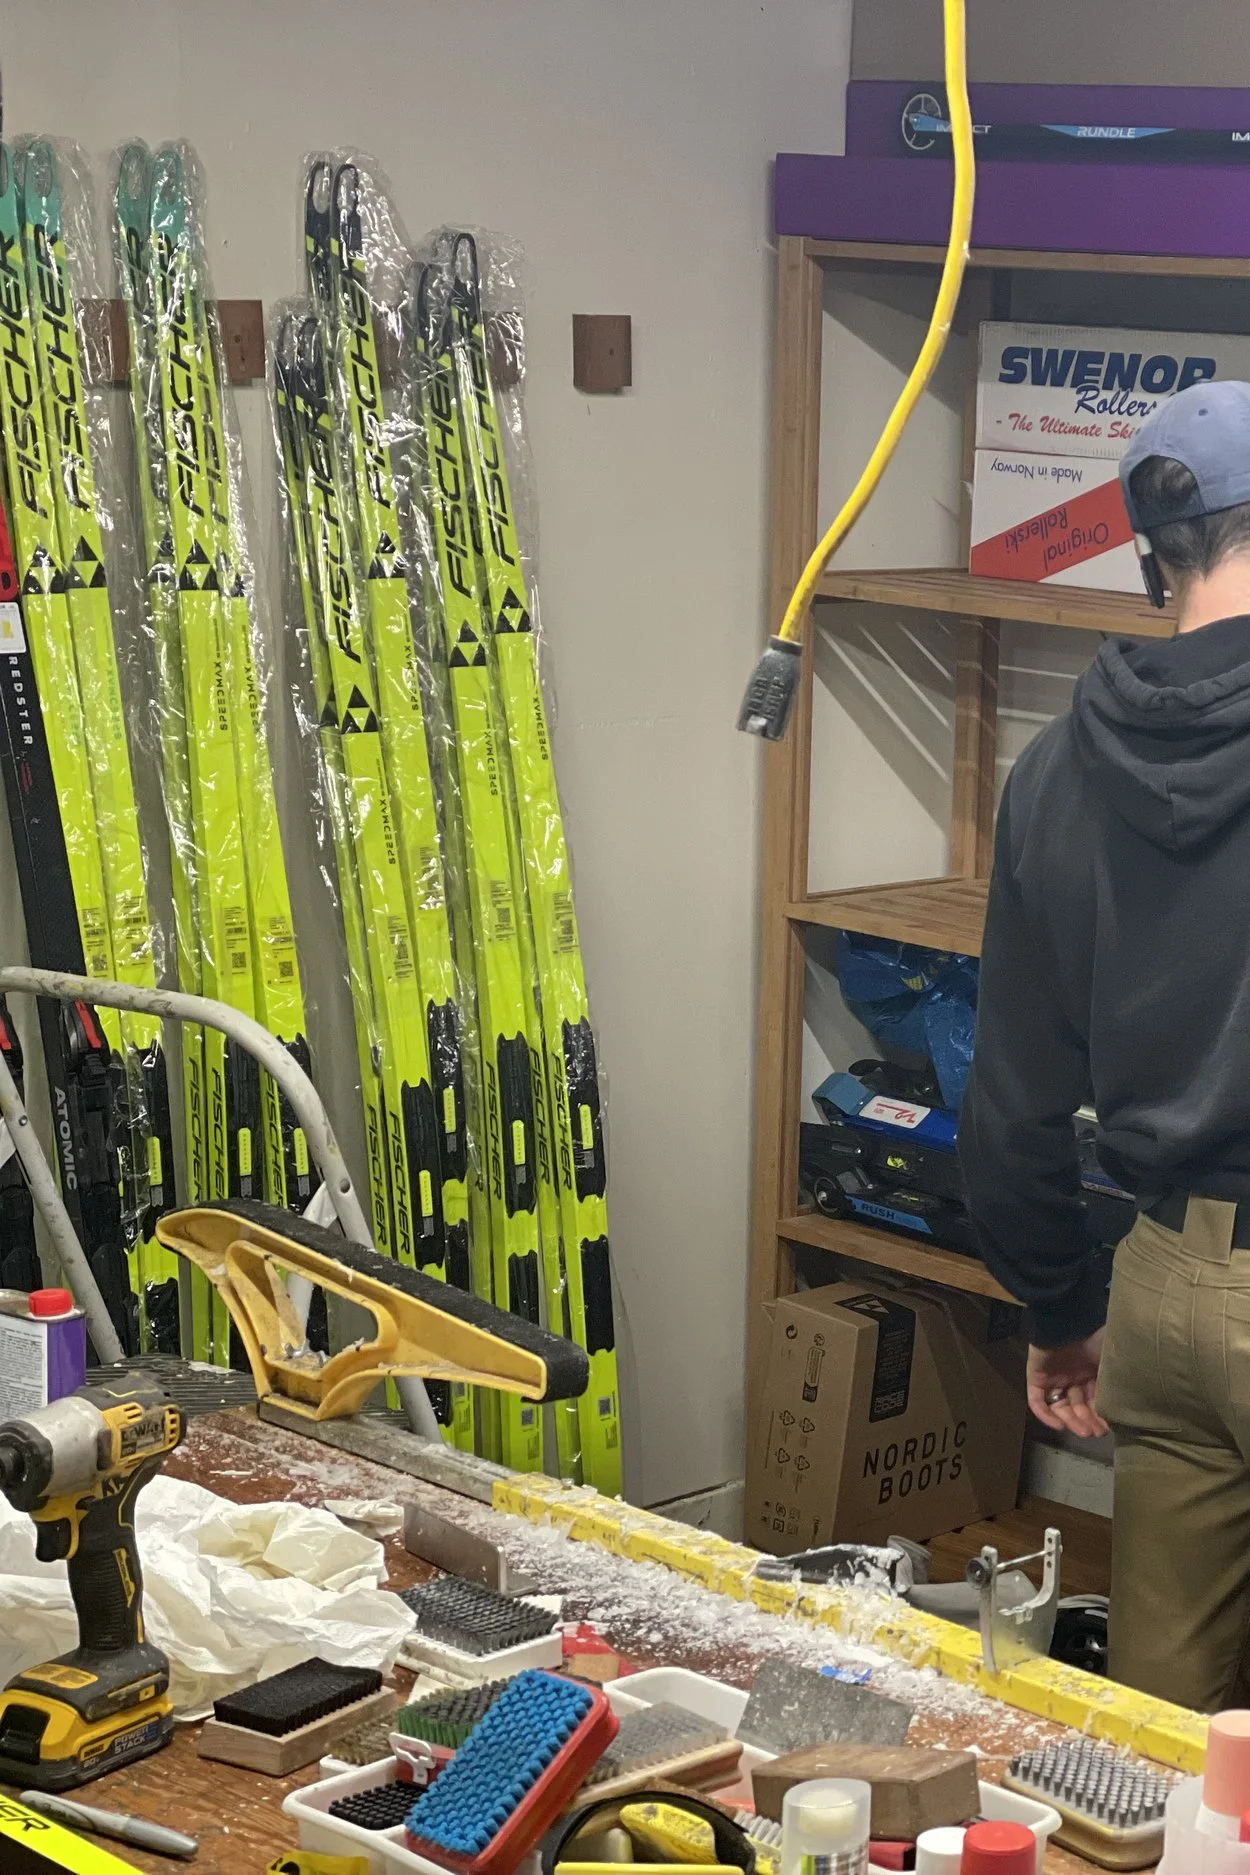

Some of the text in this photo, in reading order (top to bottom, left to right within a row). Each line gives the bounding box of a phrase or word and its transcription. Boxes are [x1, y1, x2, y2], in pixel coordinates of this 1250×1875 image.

[936, 123, 991, 134] IMCT
[1076, 126, 1136, 139] RUNDLE
[1008, 412, 1034, 433] The
[1040, 416, 1103, 438] Ultimate
[1107, 420, 1140, 440] Ski
[991, 457, 1083, 485] Made in Norway
[1004, 508, 1069, 554] Rollerski
[1043, 523, 1110, 572] Original
[9, 655, 34, 746] REDSTER
[213, 661, 228, 731] SPEEDMAX
[532, 695, 549, 761] SPEEDMAX
[484, 731, 499, 797] SPEEDMAX
[379, 798, 396, 866] SPEEDMAX
[54, 1085, 78, 1191] ATOMIC
[486, 1060, 502, 1200] FISCHER
[529, 1047, 551, 1185] FISCHER
[366, 1103, 388, 1246] FISCHER
[388, 1110, 411, 1255] FISCHER
[863, 1421, 968, 1479] NORDIC
[878, 1453, 963, 1505] BOOTS
[0, 1802, 50, 1831] ER
